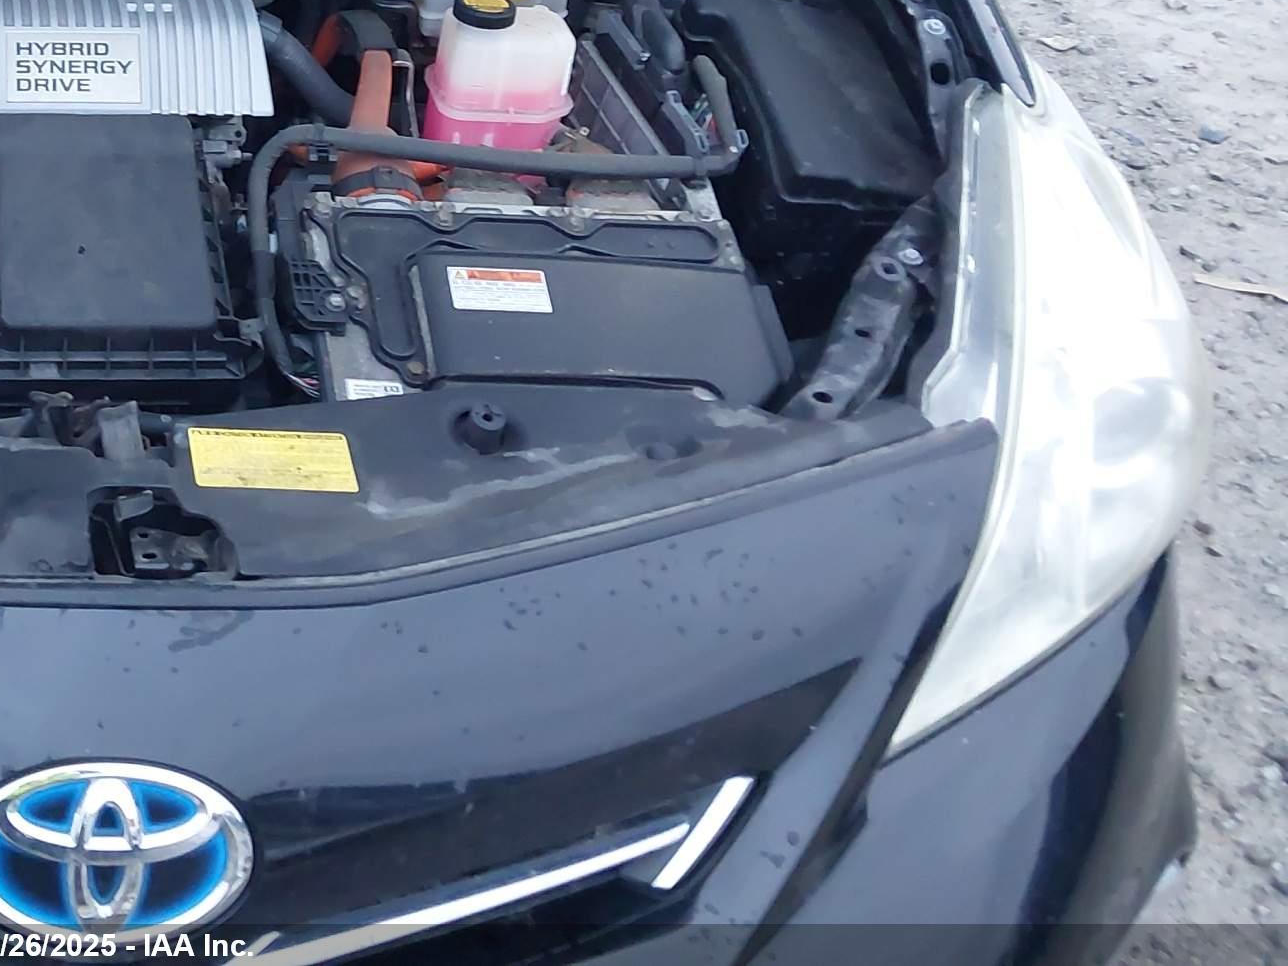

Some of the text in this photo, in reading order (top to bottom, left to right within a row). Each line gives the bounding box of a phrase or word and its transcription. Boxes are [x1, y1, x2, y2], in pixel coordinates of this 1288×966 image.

[16, 42, 109, 56] HYBRID
[16, 60, 133, 74] SYNERGY
[16, 78, 91, 92] DRIVE
